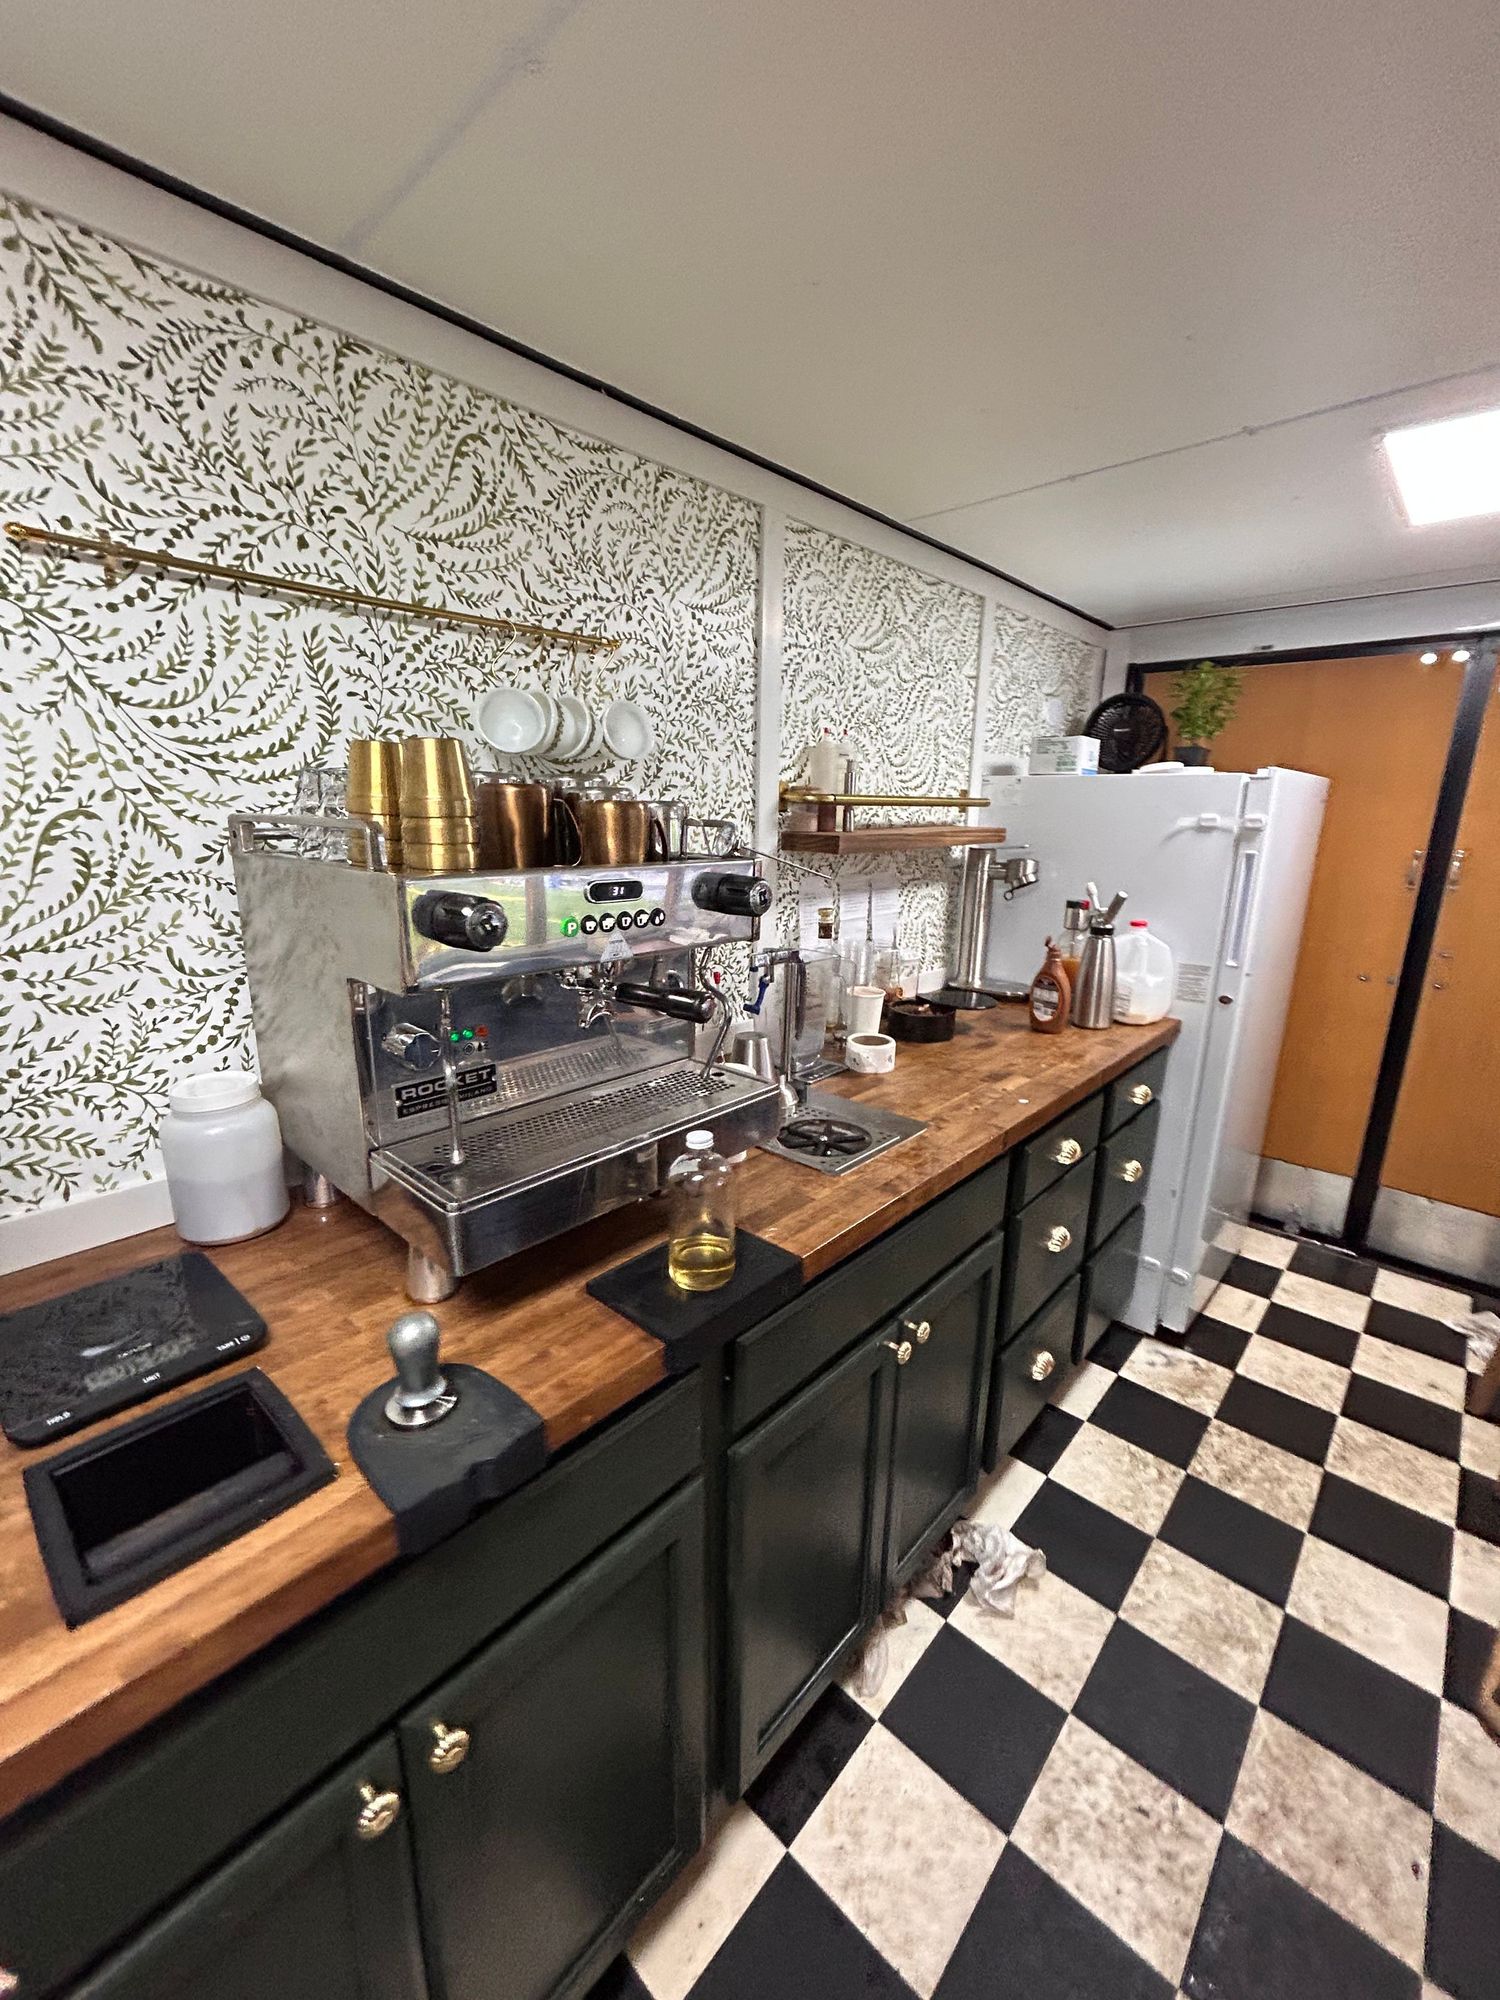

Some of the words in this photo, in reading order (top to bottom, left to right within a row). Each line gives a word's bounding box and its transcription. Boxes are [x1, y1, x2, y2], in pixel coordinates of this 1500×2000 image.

[567, 922, 577, 935] P
[401, 1068, 491, 1100] ROCKET
[402, 1098, 449, 1116] ESPRESS
